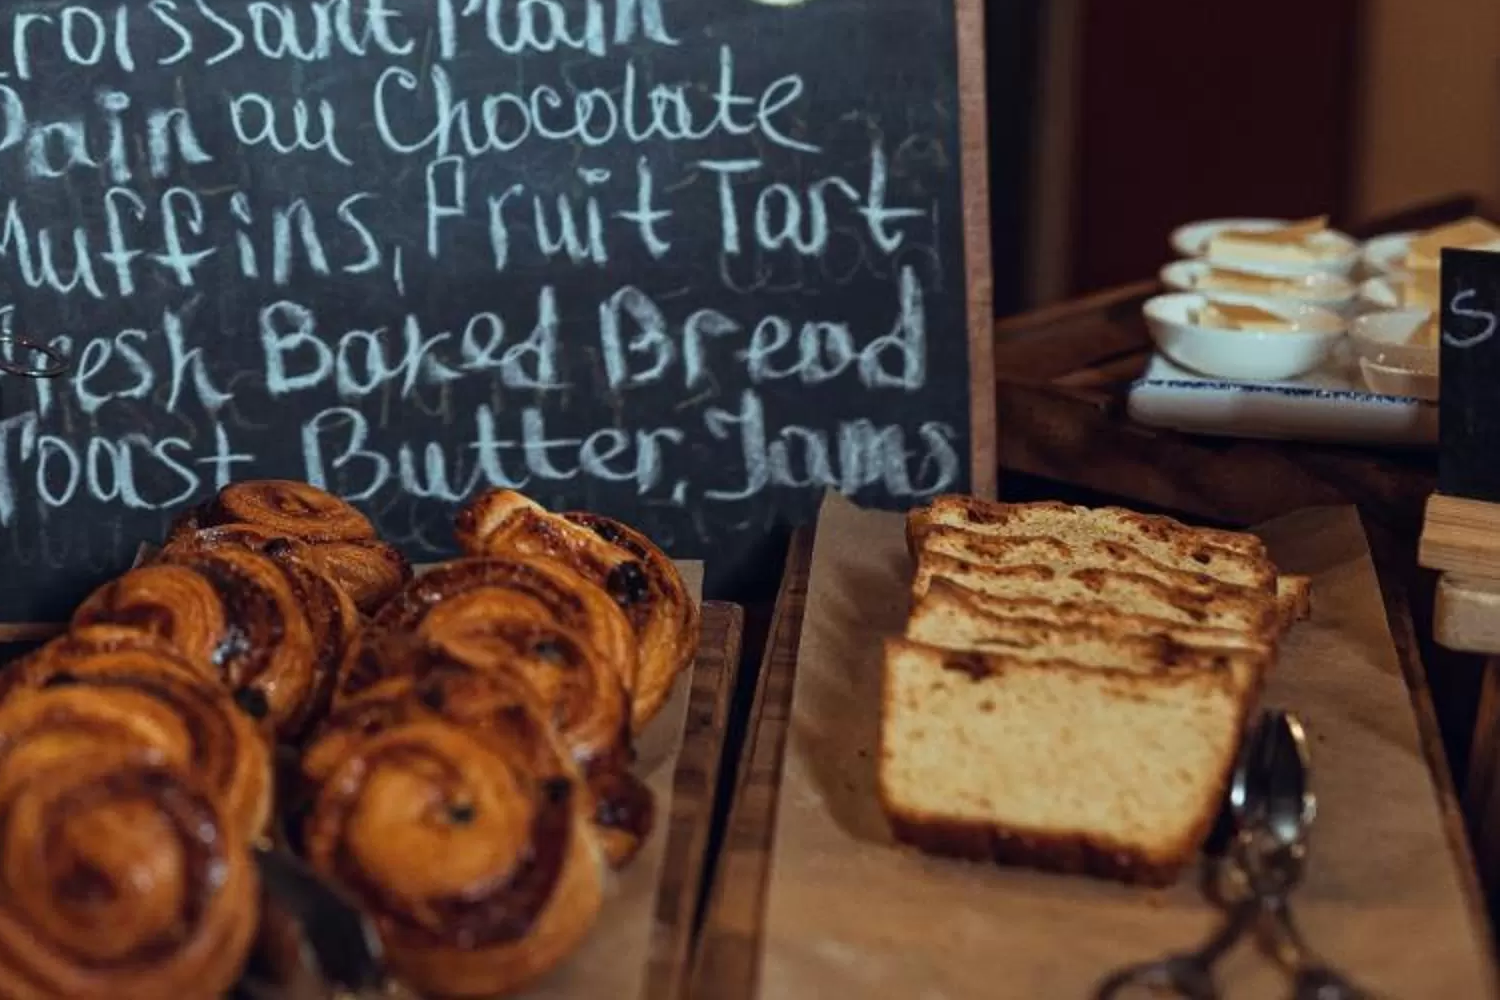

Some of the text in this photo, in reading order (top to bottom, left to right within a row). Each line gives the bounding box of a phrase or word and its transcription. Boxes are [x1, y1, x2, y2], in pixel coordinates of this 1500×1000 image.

[229, 93, 354, 166] au
[374, 44, 823, 157] Chocolate
[698, 138, 926, 256] Tart
[259, 284, 574, 400] Baked
[599, 264, 929, 390] Bread
[703, 389, 961, 501] Jams
